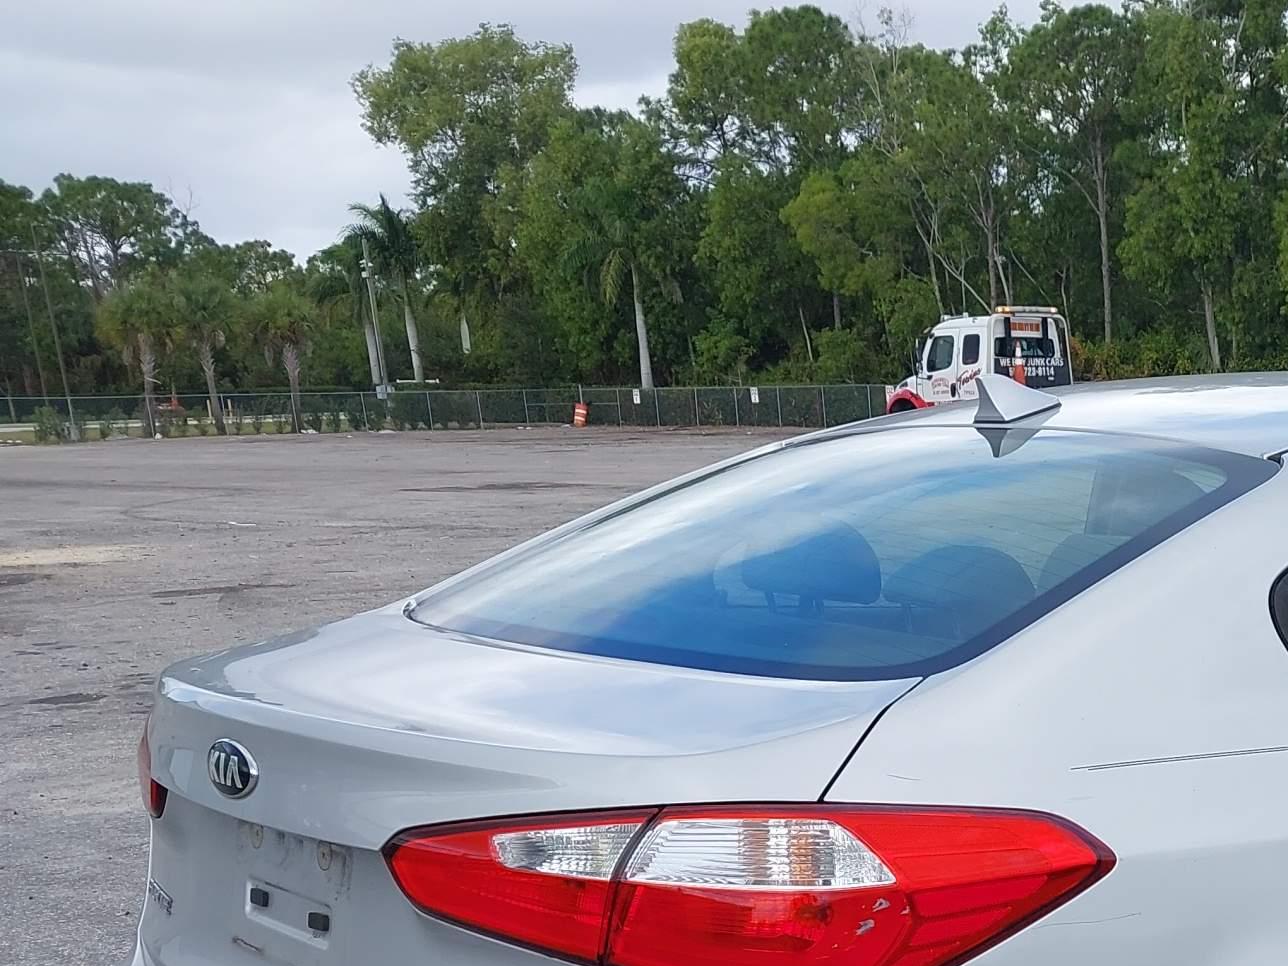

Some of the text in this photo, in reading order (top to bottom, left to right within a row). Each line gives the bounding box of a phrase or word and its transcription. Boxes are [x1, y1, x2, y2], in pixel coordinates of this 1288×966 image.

[1000, 358, 1011, 366] WE
[1027, 358, 1046, 366] JUNK
[1046, 358, 1064, 366] CARS
[209, 749, 243, 788] KIA
